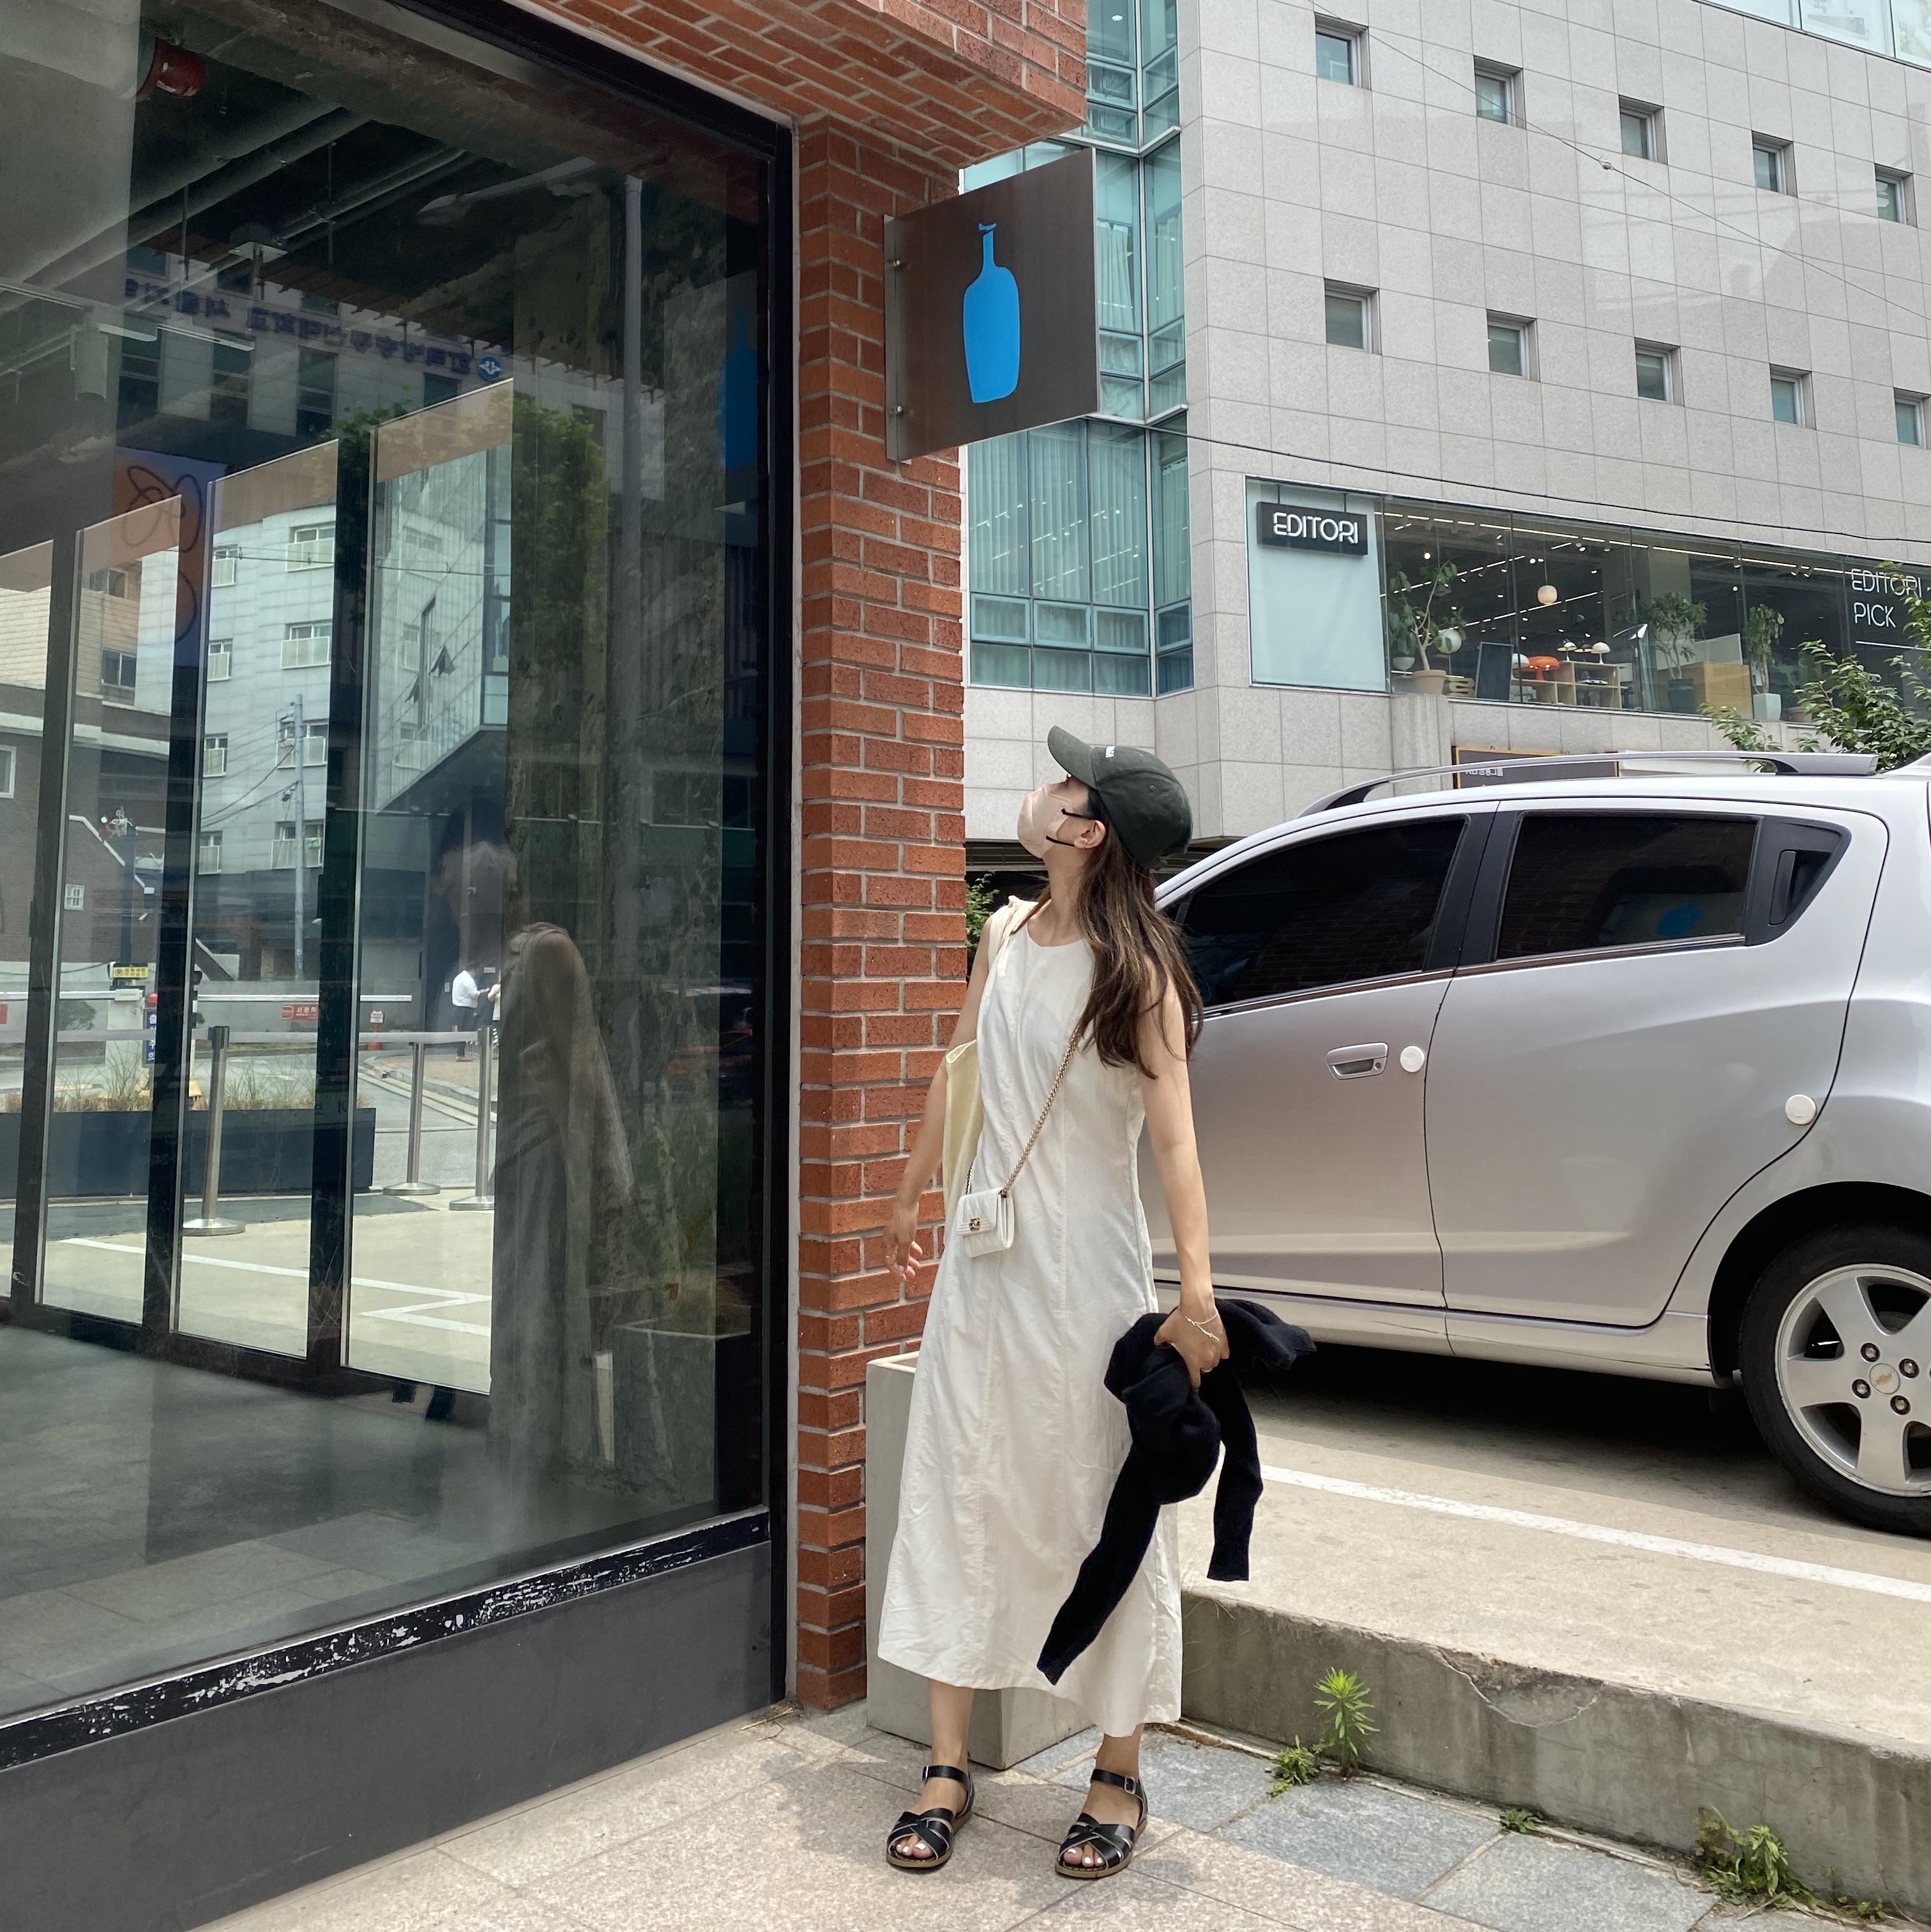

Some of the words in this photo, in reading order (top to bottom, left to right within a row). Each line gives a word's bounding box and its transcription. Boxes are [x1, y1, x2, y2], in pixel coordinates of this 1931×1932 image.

[1273, 512, 1358, 544] EDITORI
[1851, 568, 1923, 598] EDITORI
[1853, 602, 1897, 628] PICK
